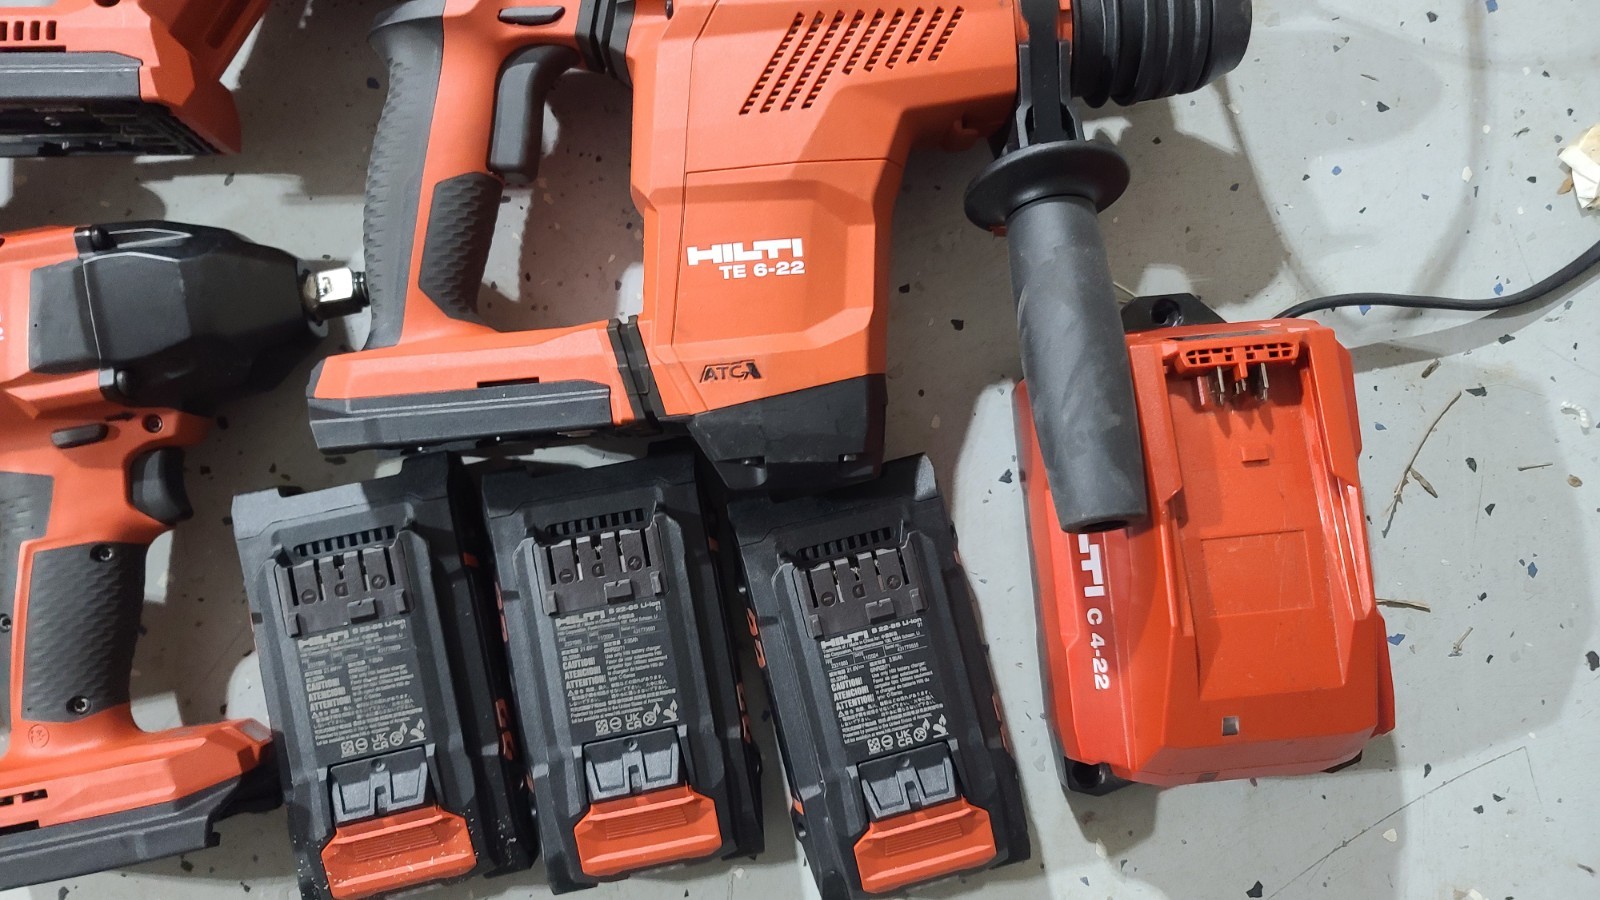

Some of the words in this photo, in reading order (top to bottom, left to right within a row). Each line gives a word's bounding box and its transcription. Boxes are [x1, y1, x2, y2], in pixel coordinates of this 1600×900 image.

[687, 238, 803, 265] HILTI
[719, 265, 746, 279] TE
[753, 261, 805, 277] 6-22
[555, 610, 606, 627] HILTI
[298, 630, 350, 648] HILTI
[821, 630, 869, 649] HILTI
[1090, 633, 1110, 689] 4-22
[831, 677, 863, 692] CAUTION!
[833, 686, 870, 701] ATENCION!
[836, 694, 875, 710] ATTENTION!
[625, 713, 641, 722] UK
[626, 720, 643, 730] CA
[896, 730, 911, 739] UK
[898, 737, 914, 747] CA
